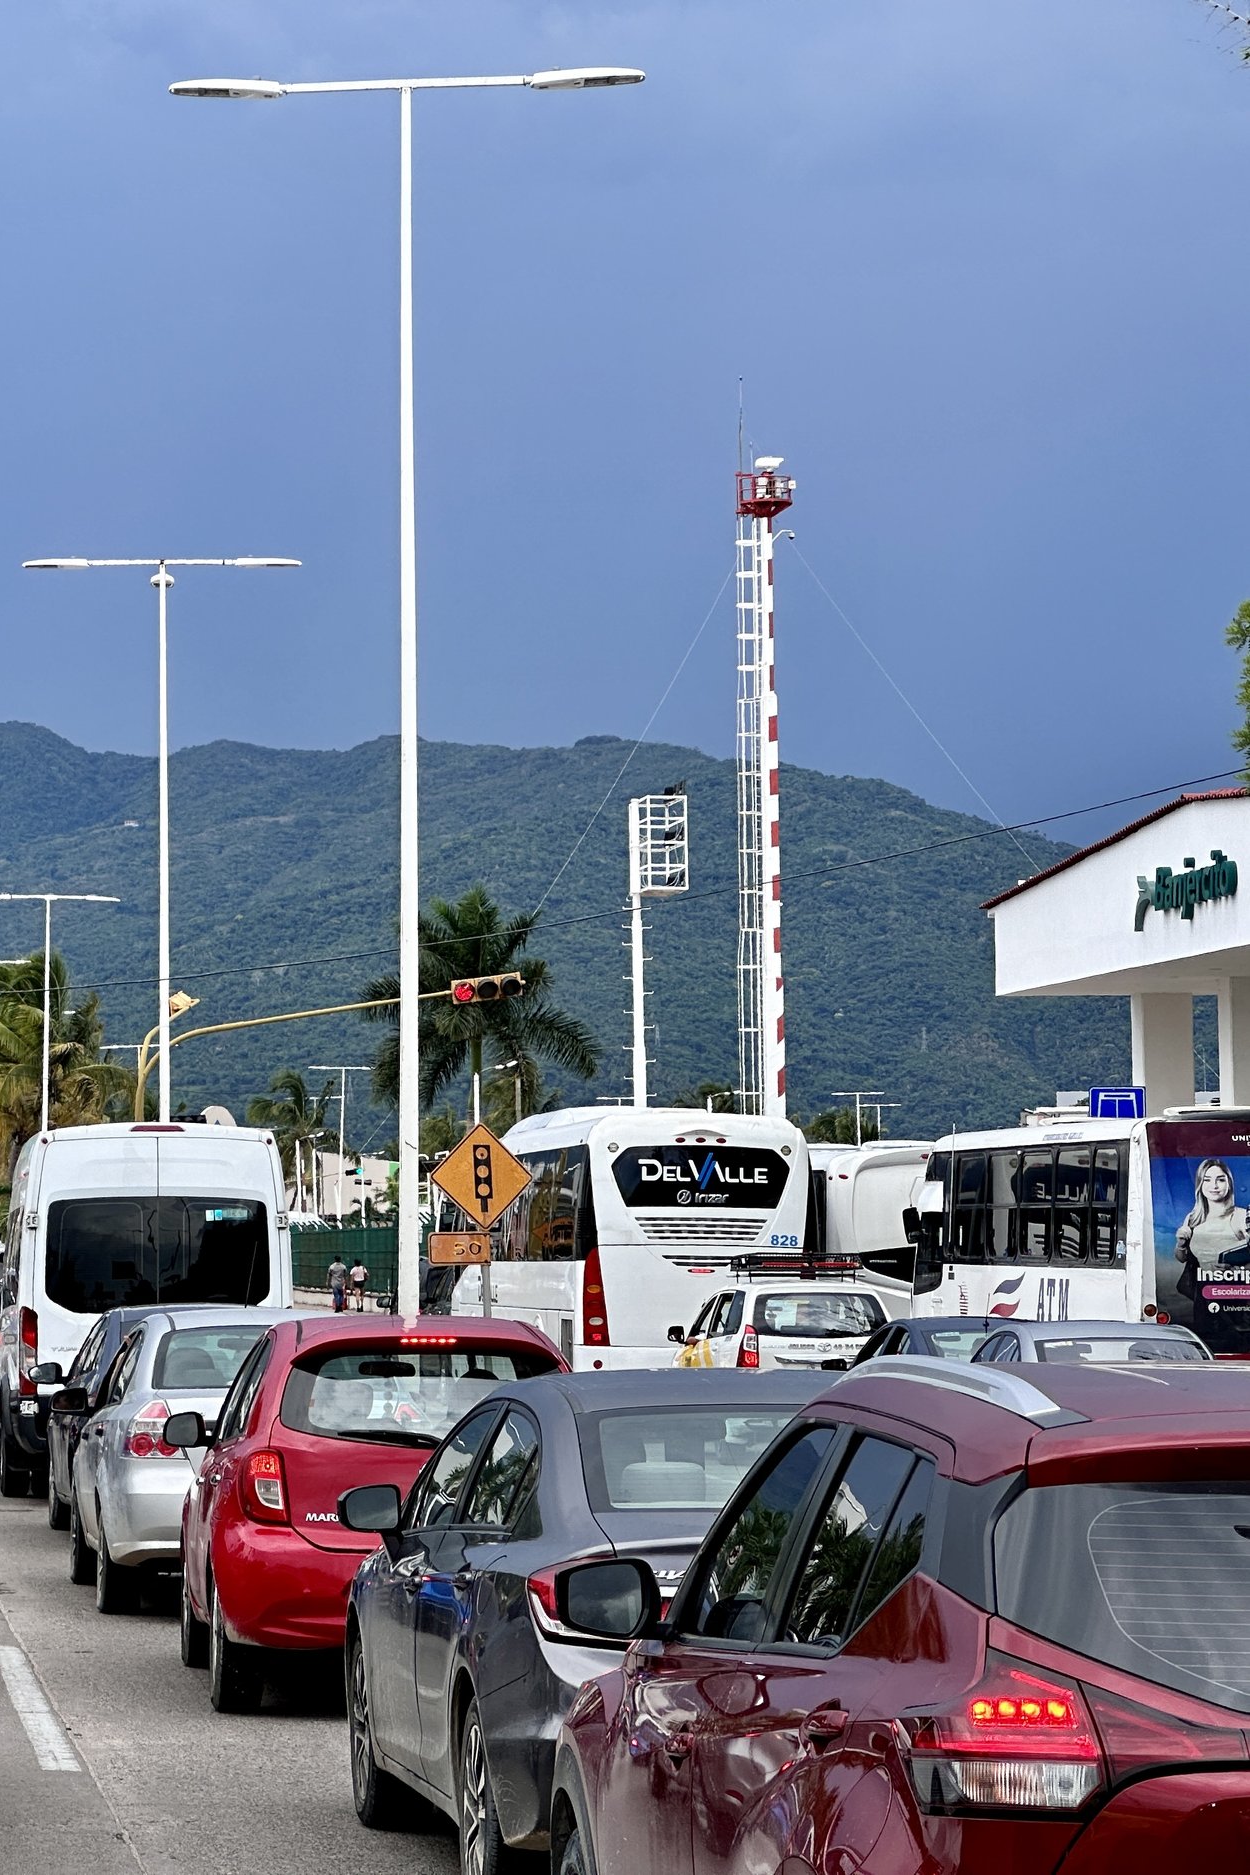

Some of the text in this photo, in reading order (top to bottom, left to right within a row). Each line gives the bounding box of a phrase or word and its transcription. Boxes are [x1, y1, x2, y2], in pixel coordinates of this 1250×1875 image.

[770, 1234, 799, 1247] 828
[454, 1242, 482, 1256] 50
[1036, 1278, 1070, 1322] ATM
